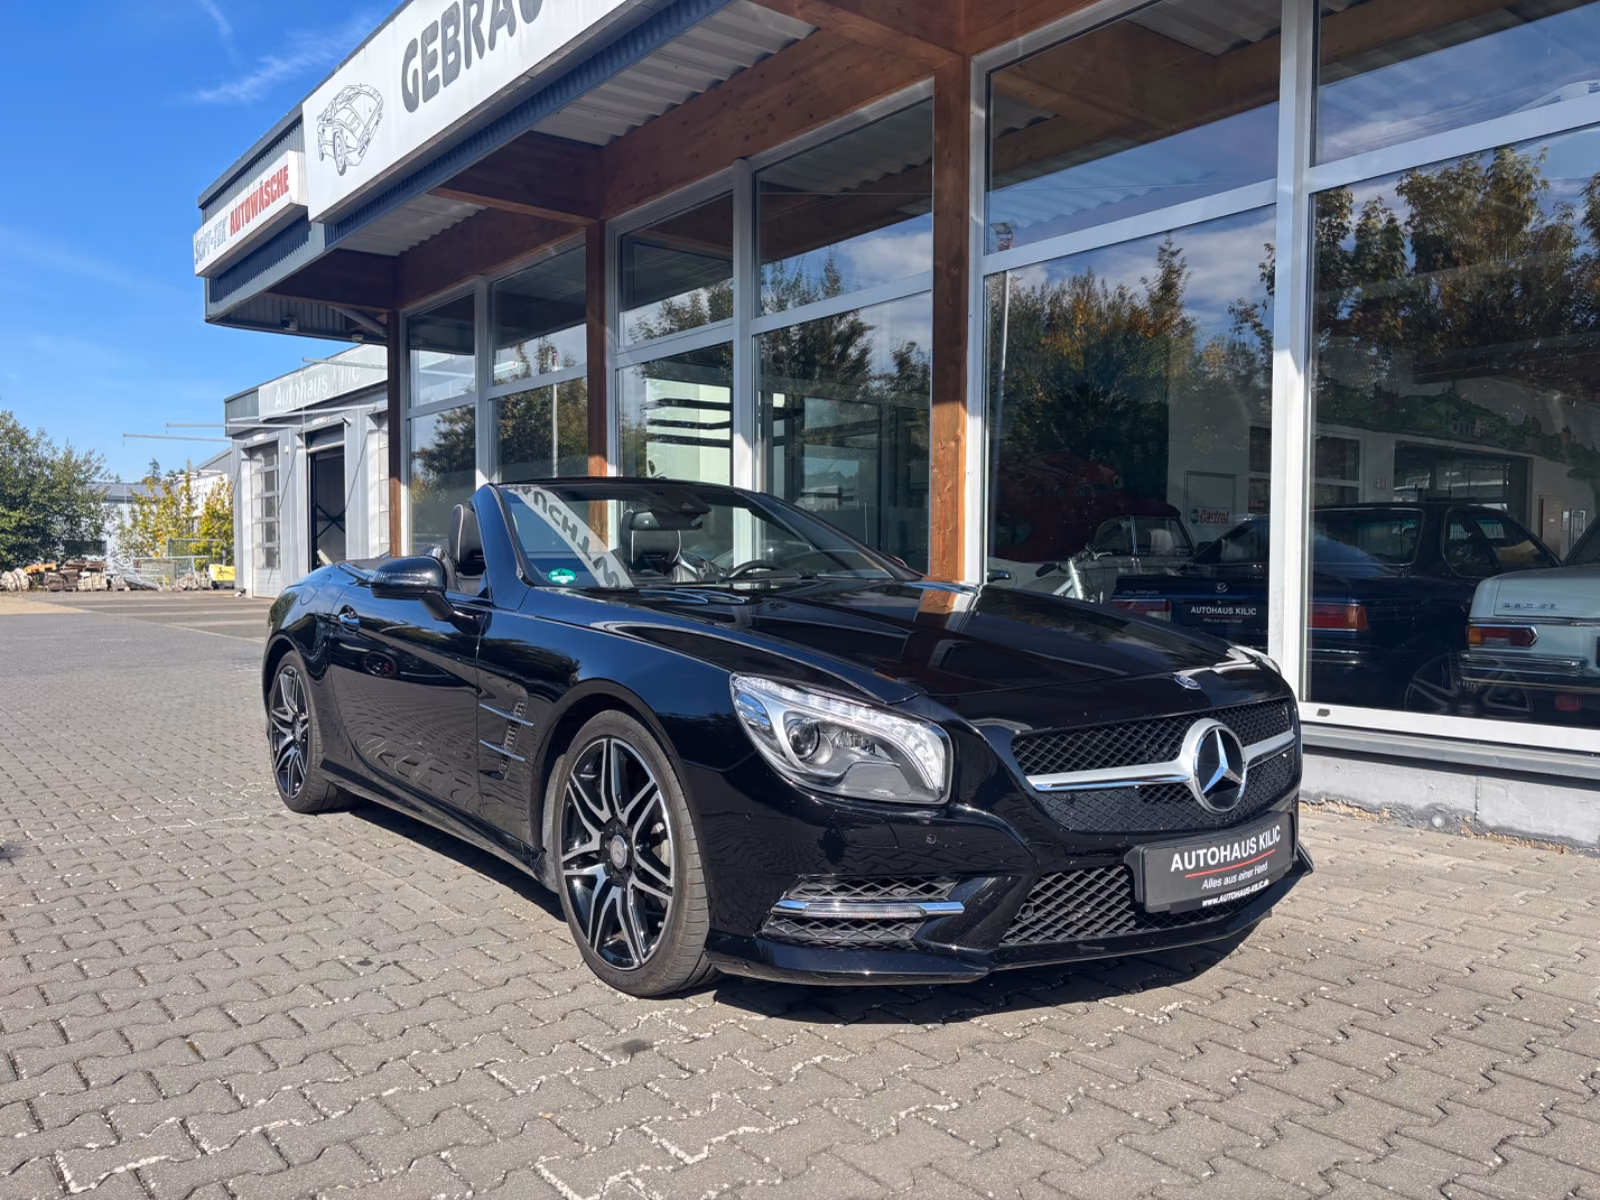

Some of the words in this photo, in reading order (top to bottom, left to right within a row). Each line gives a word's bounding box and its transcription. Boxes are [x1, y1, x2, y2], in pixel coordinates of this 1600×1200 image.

[274, 373, 329, 409] Autohaus
[1199, 509, 1230, 525] Castrol
[1190, 606, 1234, 615] AUTOHAUS
[1235, 607, 1257, 616] KILIC
[1170, 836, 1257, 872] AUTOHAUS
[1259, 825, 1281, 852] KILIC
[1201, 877, 1222, 890] Alles
[1223, 874, 1237, 885] aus
[1238, 868, 1254, 881] einer
